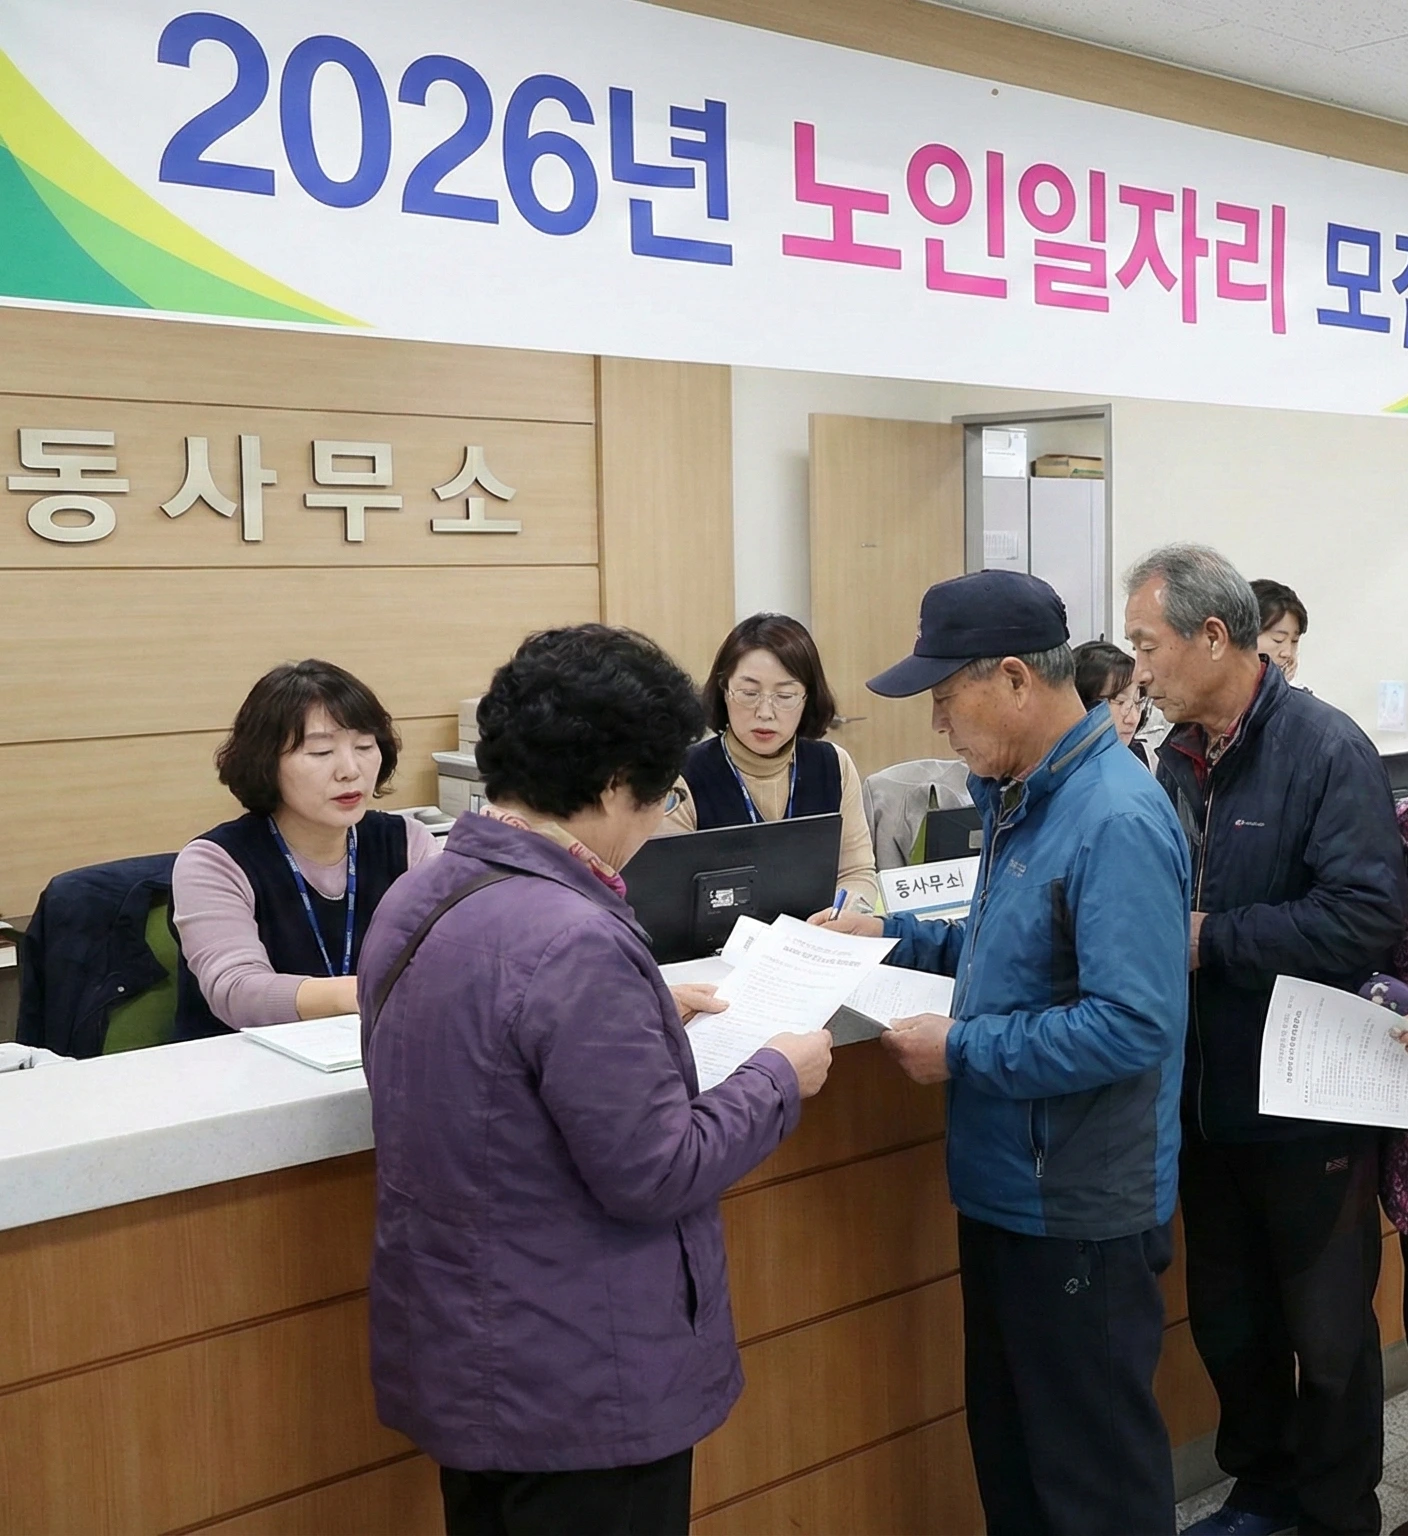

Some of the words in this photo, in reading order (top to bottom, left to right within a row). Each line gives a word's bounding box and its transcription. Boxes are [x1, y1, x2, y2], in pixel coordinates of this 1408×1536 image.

[157, 11, 734, 266] 2026년
[781, 121, 1287, 335] 노인일자리
[6, 426, 523, 543] 동사무소
